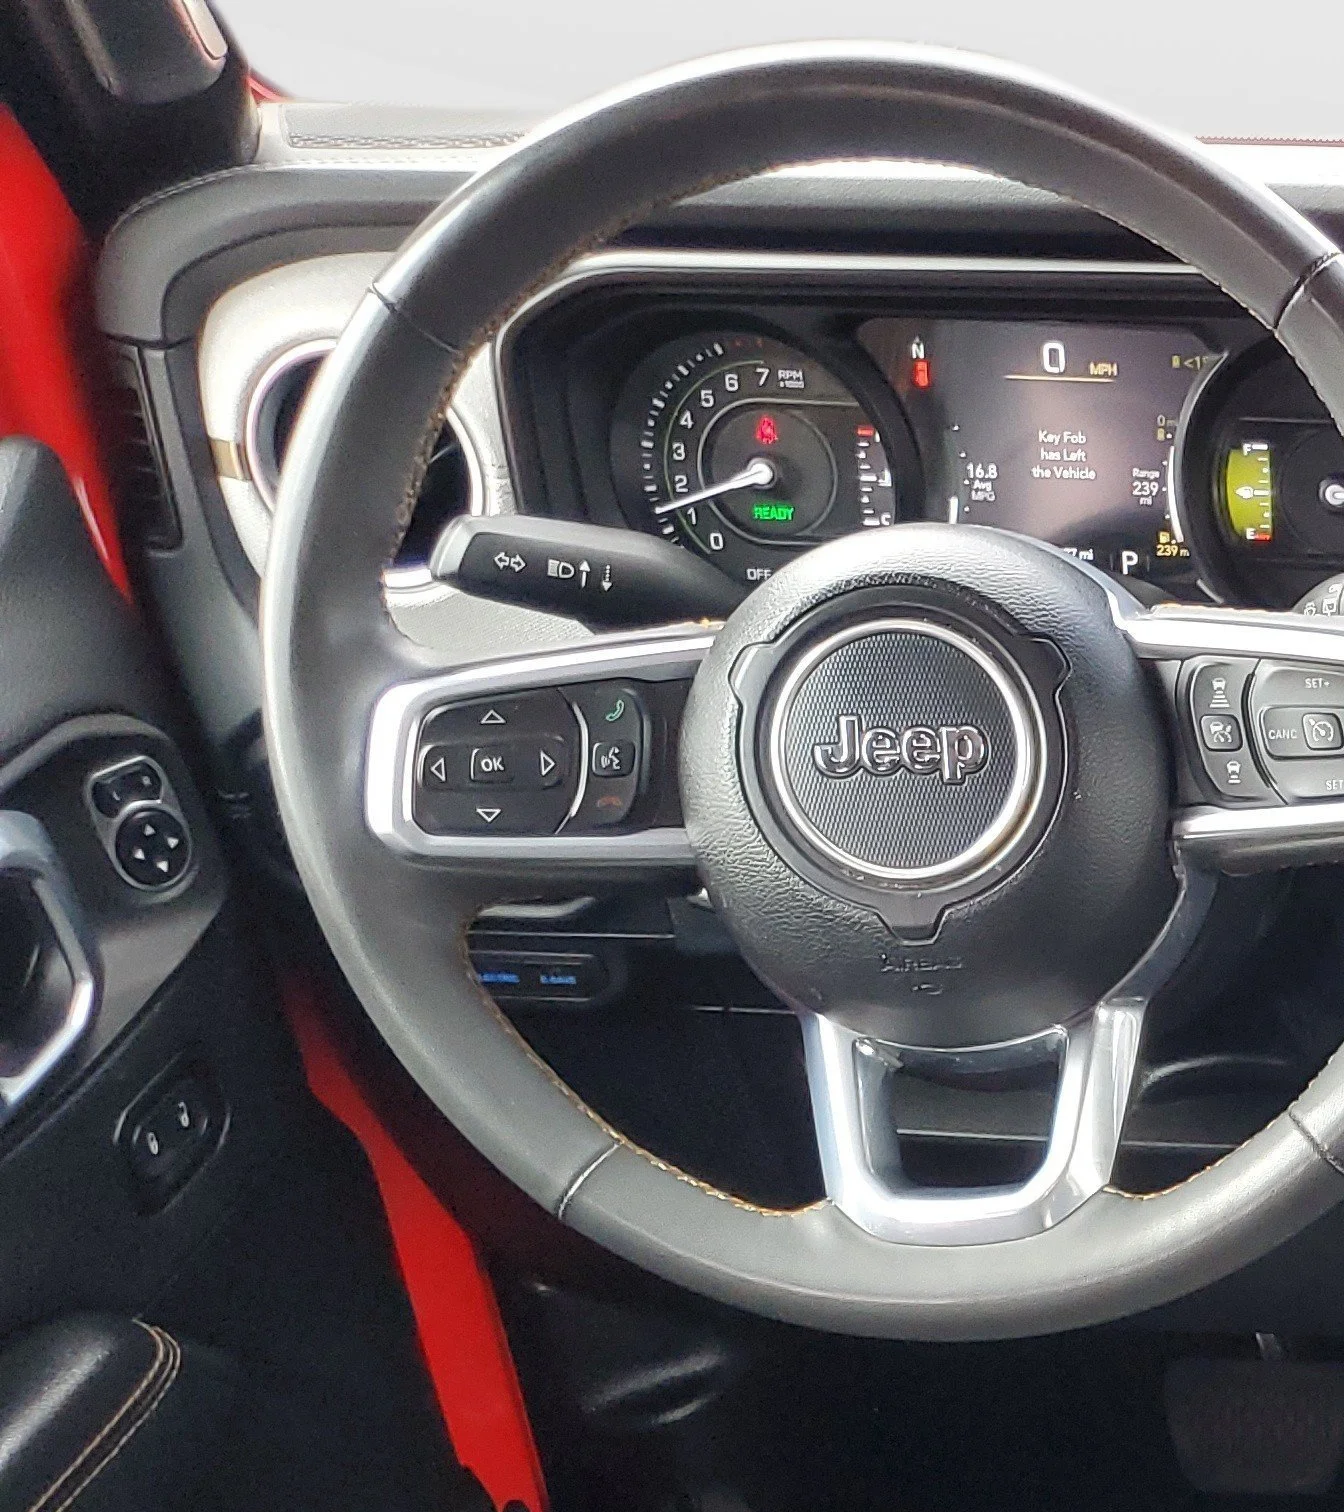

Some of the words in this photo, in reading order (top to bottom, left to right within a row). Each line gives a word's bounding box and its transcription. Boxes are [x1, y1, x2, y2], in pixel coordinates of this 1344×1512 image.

[911, 342, 925, 359] N
[755, 367, 770, 387] 7
[777, 369, 804, 382] RPM
[1089, 361, 1119, 376] MPH
[724, 373, 739, 392] 6
[700, 389, 715, 408] 5
[679, 409, 694, 429] 4
[1038, 430, 1061, 446] Key
[1063, 430, 1087, 445] Fob
[672, 441, 686, 461] 3
[1040, 447, 1061, 461] has
[1063, 448, 1087, 462] Left
[1242, 443, 1252, 456] F
[966, 462, 998, 480] 16.8
[1031, 464, 1051, 478] the
[1053, 465, 1097, 480] Vehicle
[1131, 467, 1161, 479] Range
[674, 474, 689, 493] 2
[972, 479, 993, 491] Avg
[1131, 480, 1160, 496] 239
[686, 506, 698, 526] 1
[753, 504, 795, 521] READY
[709, 531, 725, 551] 0
[1245, 527, 1256, 540] E
[1156, 544, 1179, 557] 239
[1121, 550, 1139, 575] P
[746, 568, 772, 581] OFF
[812, 713, 990, 786] Jeep
[480, 754, 505, 773] OK
